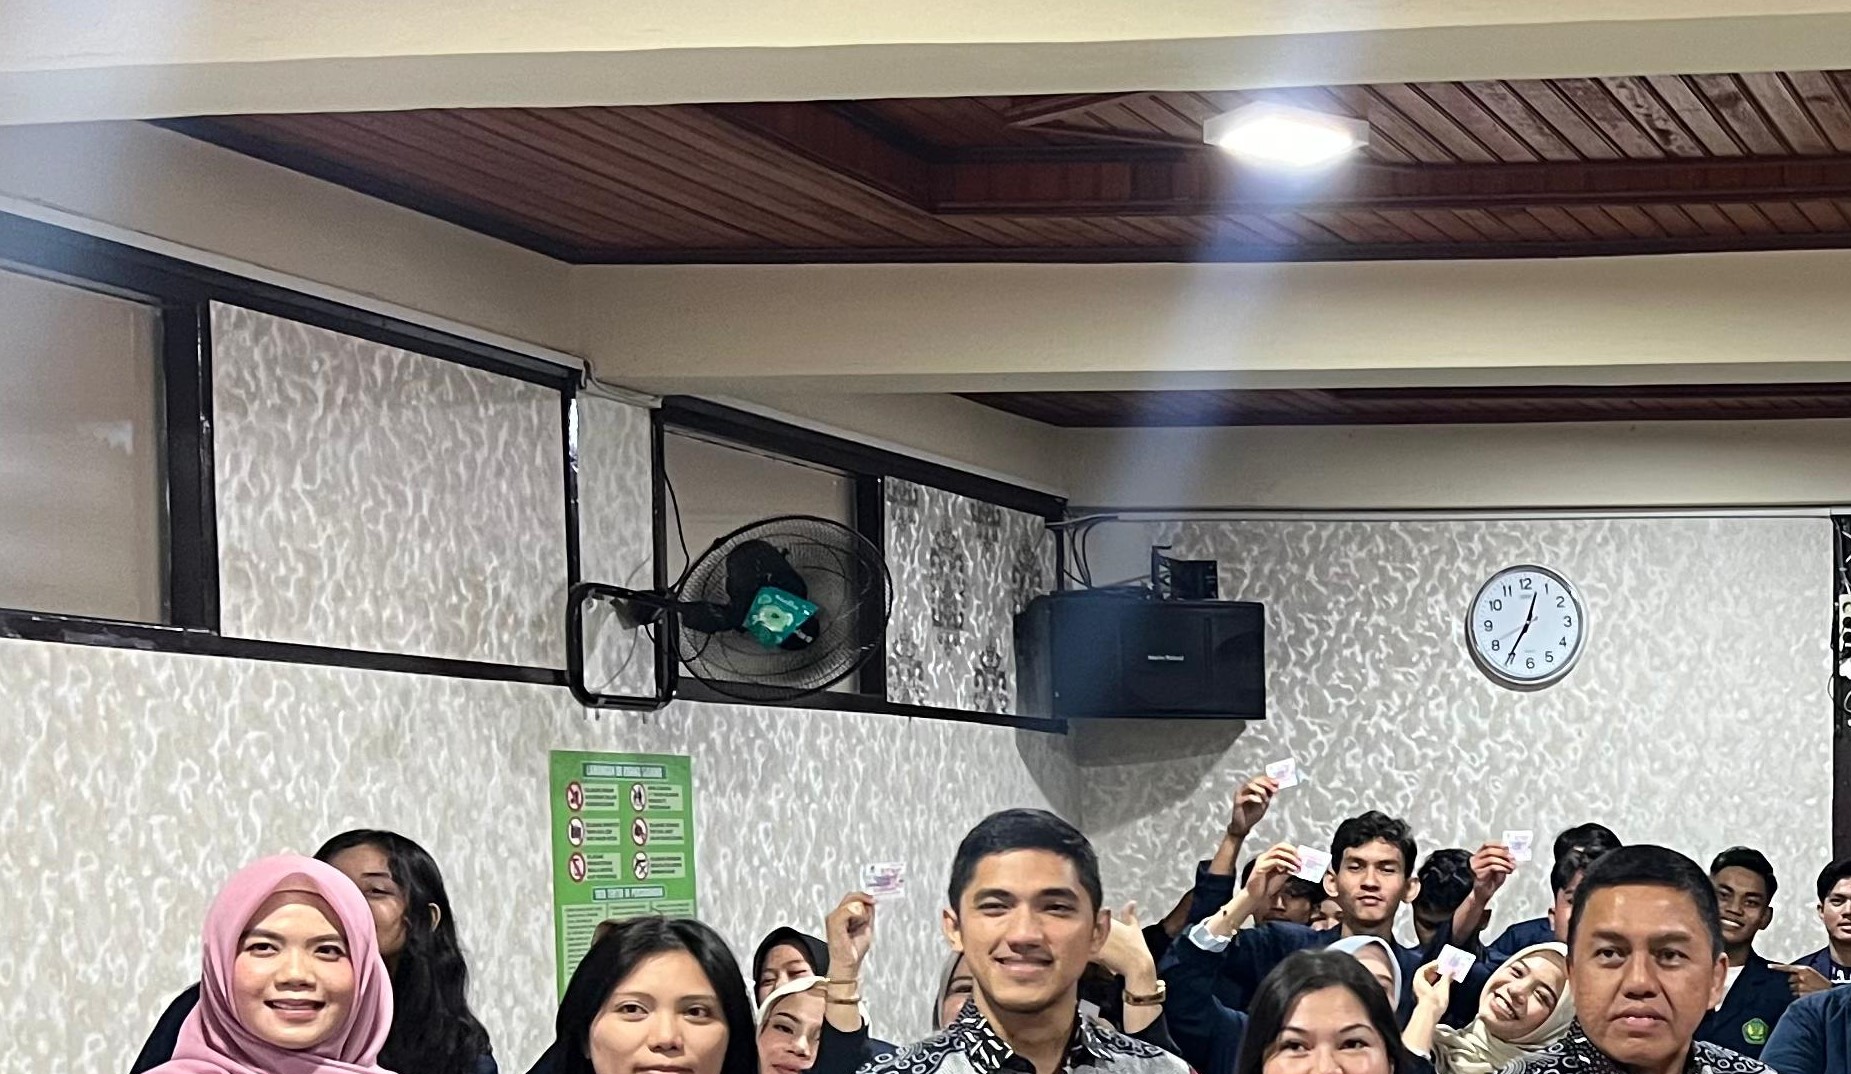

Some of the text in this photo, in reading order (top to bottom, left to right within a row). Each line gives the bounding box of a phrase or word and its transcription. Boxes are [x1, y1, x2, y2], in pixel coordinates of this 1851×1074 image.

[1519, 577, 1533, 590] 12
[1502, 584, 1513, 597] 11
[1489, 598, 1503, 611] 10
[1555, 595, 1565, 608] 2
[1483, 619, 1493, 632] 9
[1563, 615, 1572, 627] 3
[1491, 639, 1500, 651] 8
[1558, 636, 1567, 648] 4
[1525, 657, 1535, 669] 6
[1544, 650, 1554, 663] 5
